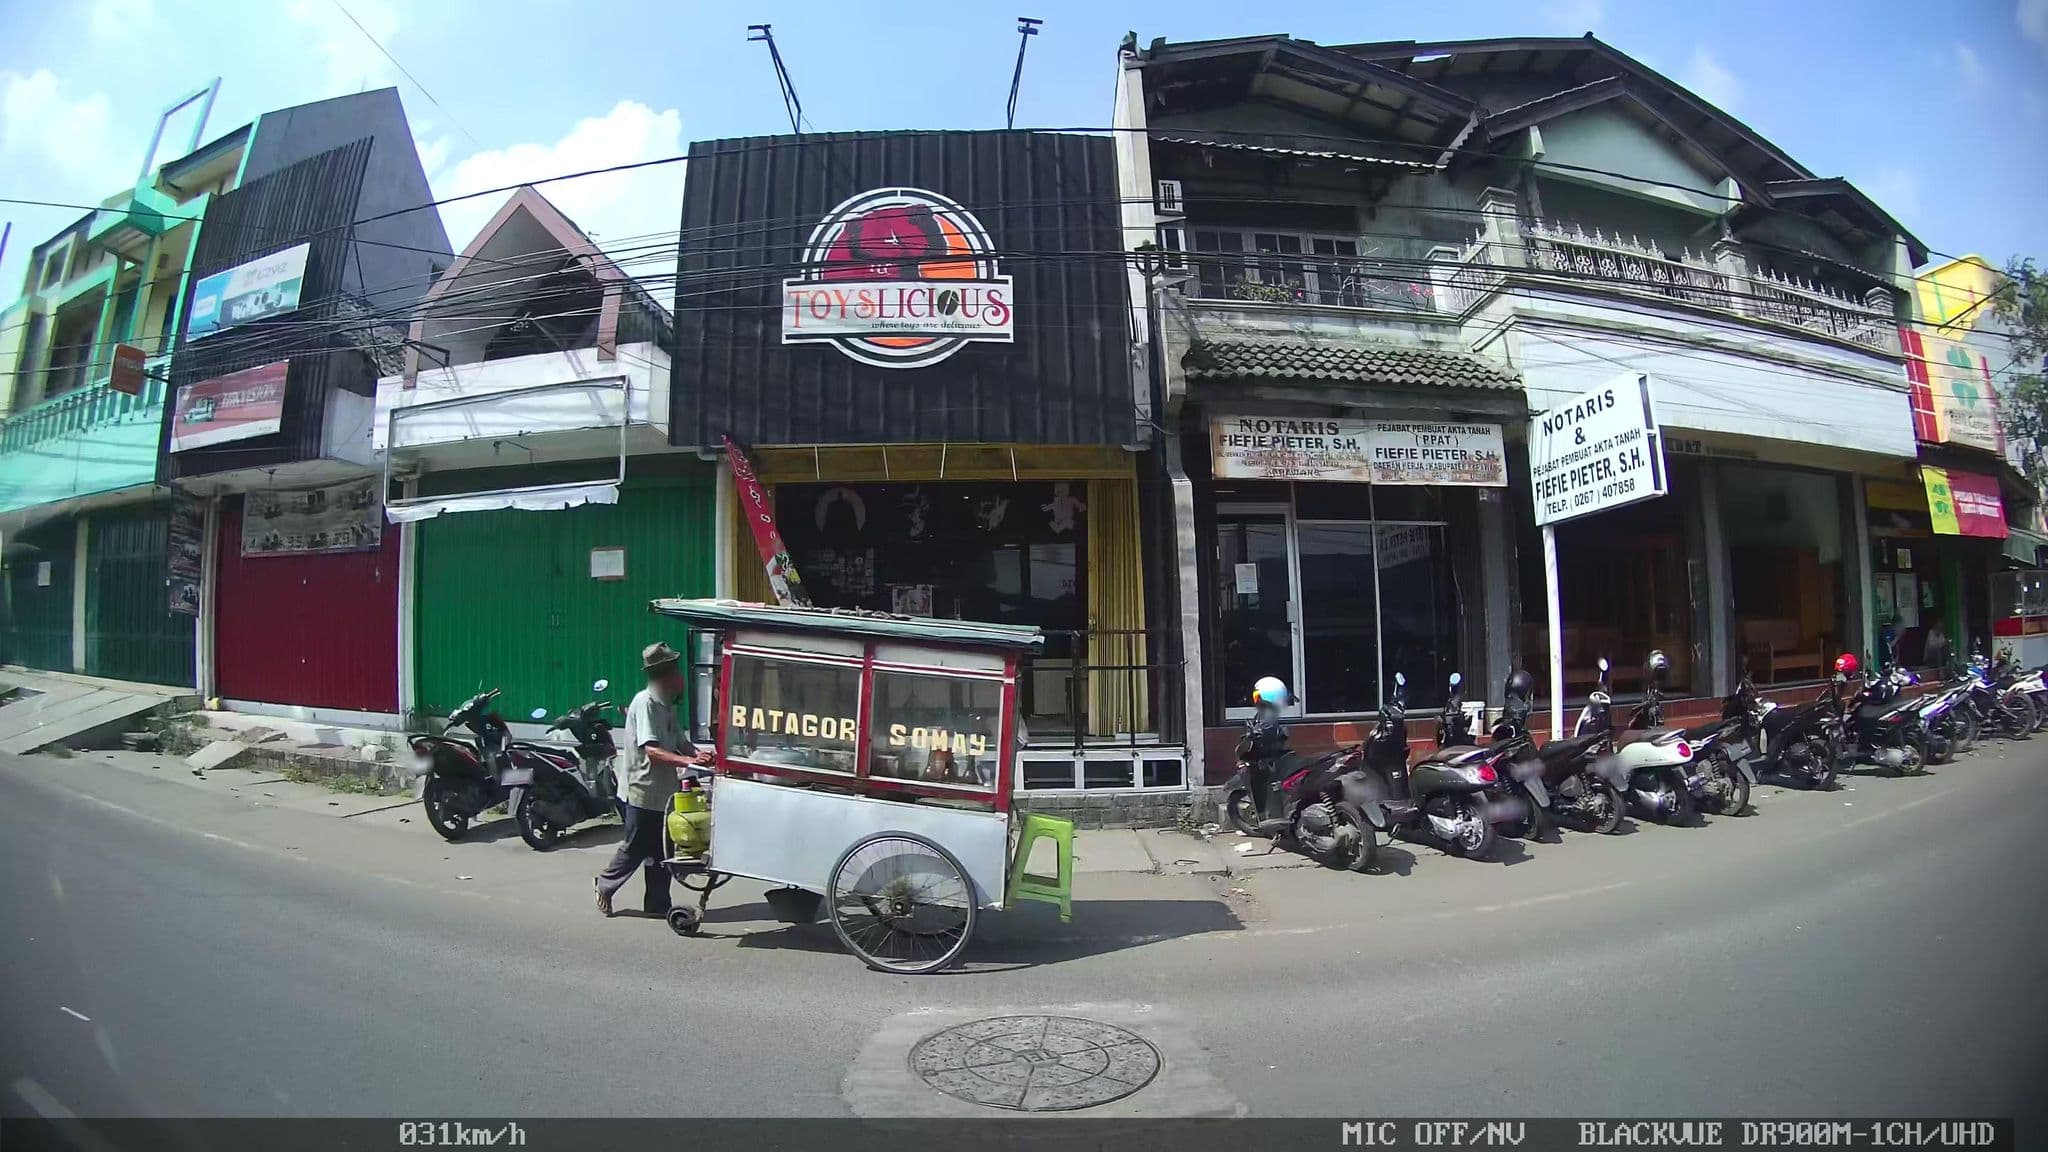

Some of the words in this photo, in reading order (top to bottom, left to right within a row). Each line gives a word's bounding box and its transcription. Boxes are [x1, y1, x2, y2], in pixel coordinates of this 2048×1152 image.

[786, 288, 1010, 328] TOYSLICIOUS
[1543, 389, 1615, 437] NOTARIS
[1240, 419, 1340, 435] NOTARIS
[1377, 423, 1411, 433] PEJABAT
[1412, 424, 1447, 434] PEMBUAT
[1447, 425, 1466, 434] AKTA
[1467, 427, 1491, 436] TANAH
[1423, 435, 1451, 446] PPAT
[1574, 427, 1586, 445] &
[1220, 434, 1266, 448] FIEFIE
[1271, 436, 1329, 451] PIETER,
[1333, 438, 1360, 449] S.H.
[1375, 448, 1418, 459] FIEFIE
[1533, 459, 1560, 478] PEJABAT
[1561, 446, 1592, 467] PEMBUAT
[1594, 439, 1614, 455] AKTA
[1614, 427, 1641, 447] TANAH
[1535, 473, 1569, 501] FIEFIE
[1570, 457, 1616, 490] PIETER,
[1618, 447, 1645, 473] S.H.
[1547, 499, 1568, 515] TELP.
[1574, 490, 1594, 507] 0267
[1602, 478, 1635, 499] 407858
[732, 705, 857, 742] BATAGOR
[889, 724, 987, 756] SOMAY
